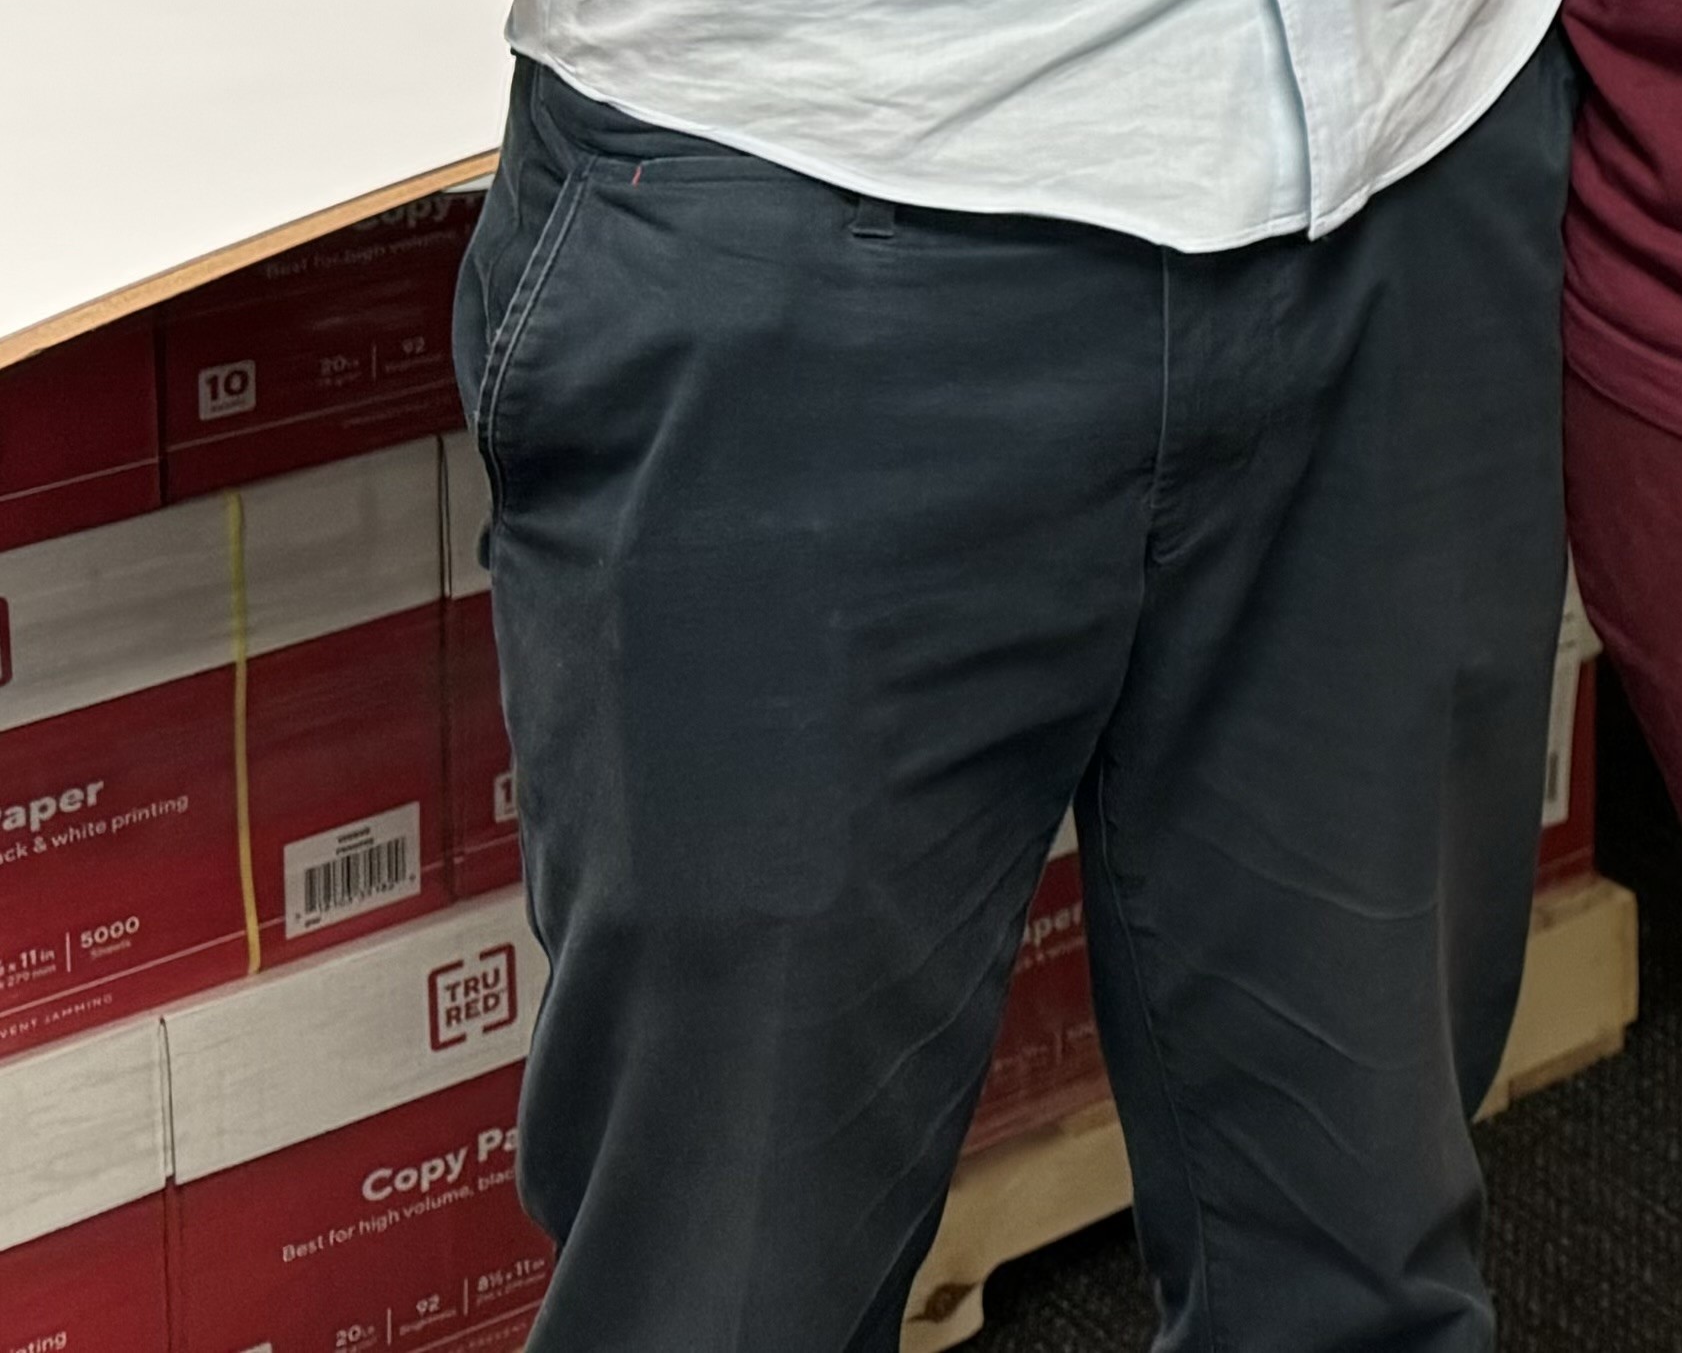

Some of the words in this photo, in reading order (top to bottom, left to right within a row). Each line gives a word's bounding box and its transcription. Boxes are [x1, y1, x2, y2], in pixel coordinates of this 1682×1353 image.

[206, 370, 249, 401] 10
[0, 780, 104, 833] aper
[33, 835, 47, 854] &
[51, 821, 107, 848] white
[111, 795, 190, 834] printing
[80, 916, 140, 949] 5000
[444, 967, 500, 1003] TRU
[445, 992, 501, 1028] RED
[362, 1147, 469, 1202] Copy
[477, 1127, 518, 1164] Pa
[283, 1235, 324, 1263] Best
[328, 1225, 356, 1247] for
[359, 1209, 400, 1236] high
[478, 1169, 515, 1192] blac
[415, 1295, 441, 1318] 92
[10, 1331, 67, 1353] ting
[335, 1325, 362, 1348] 20
